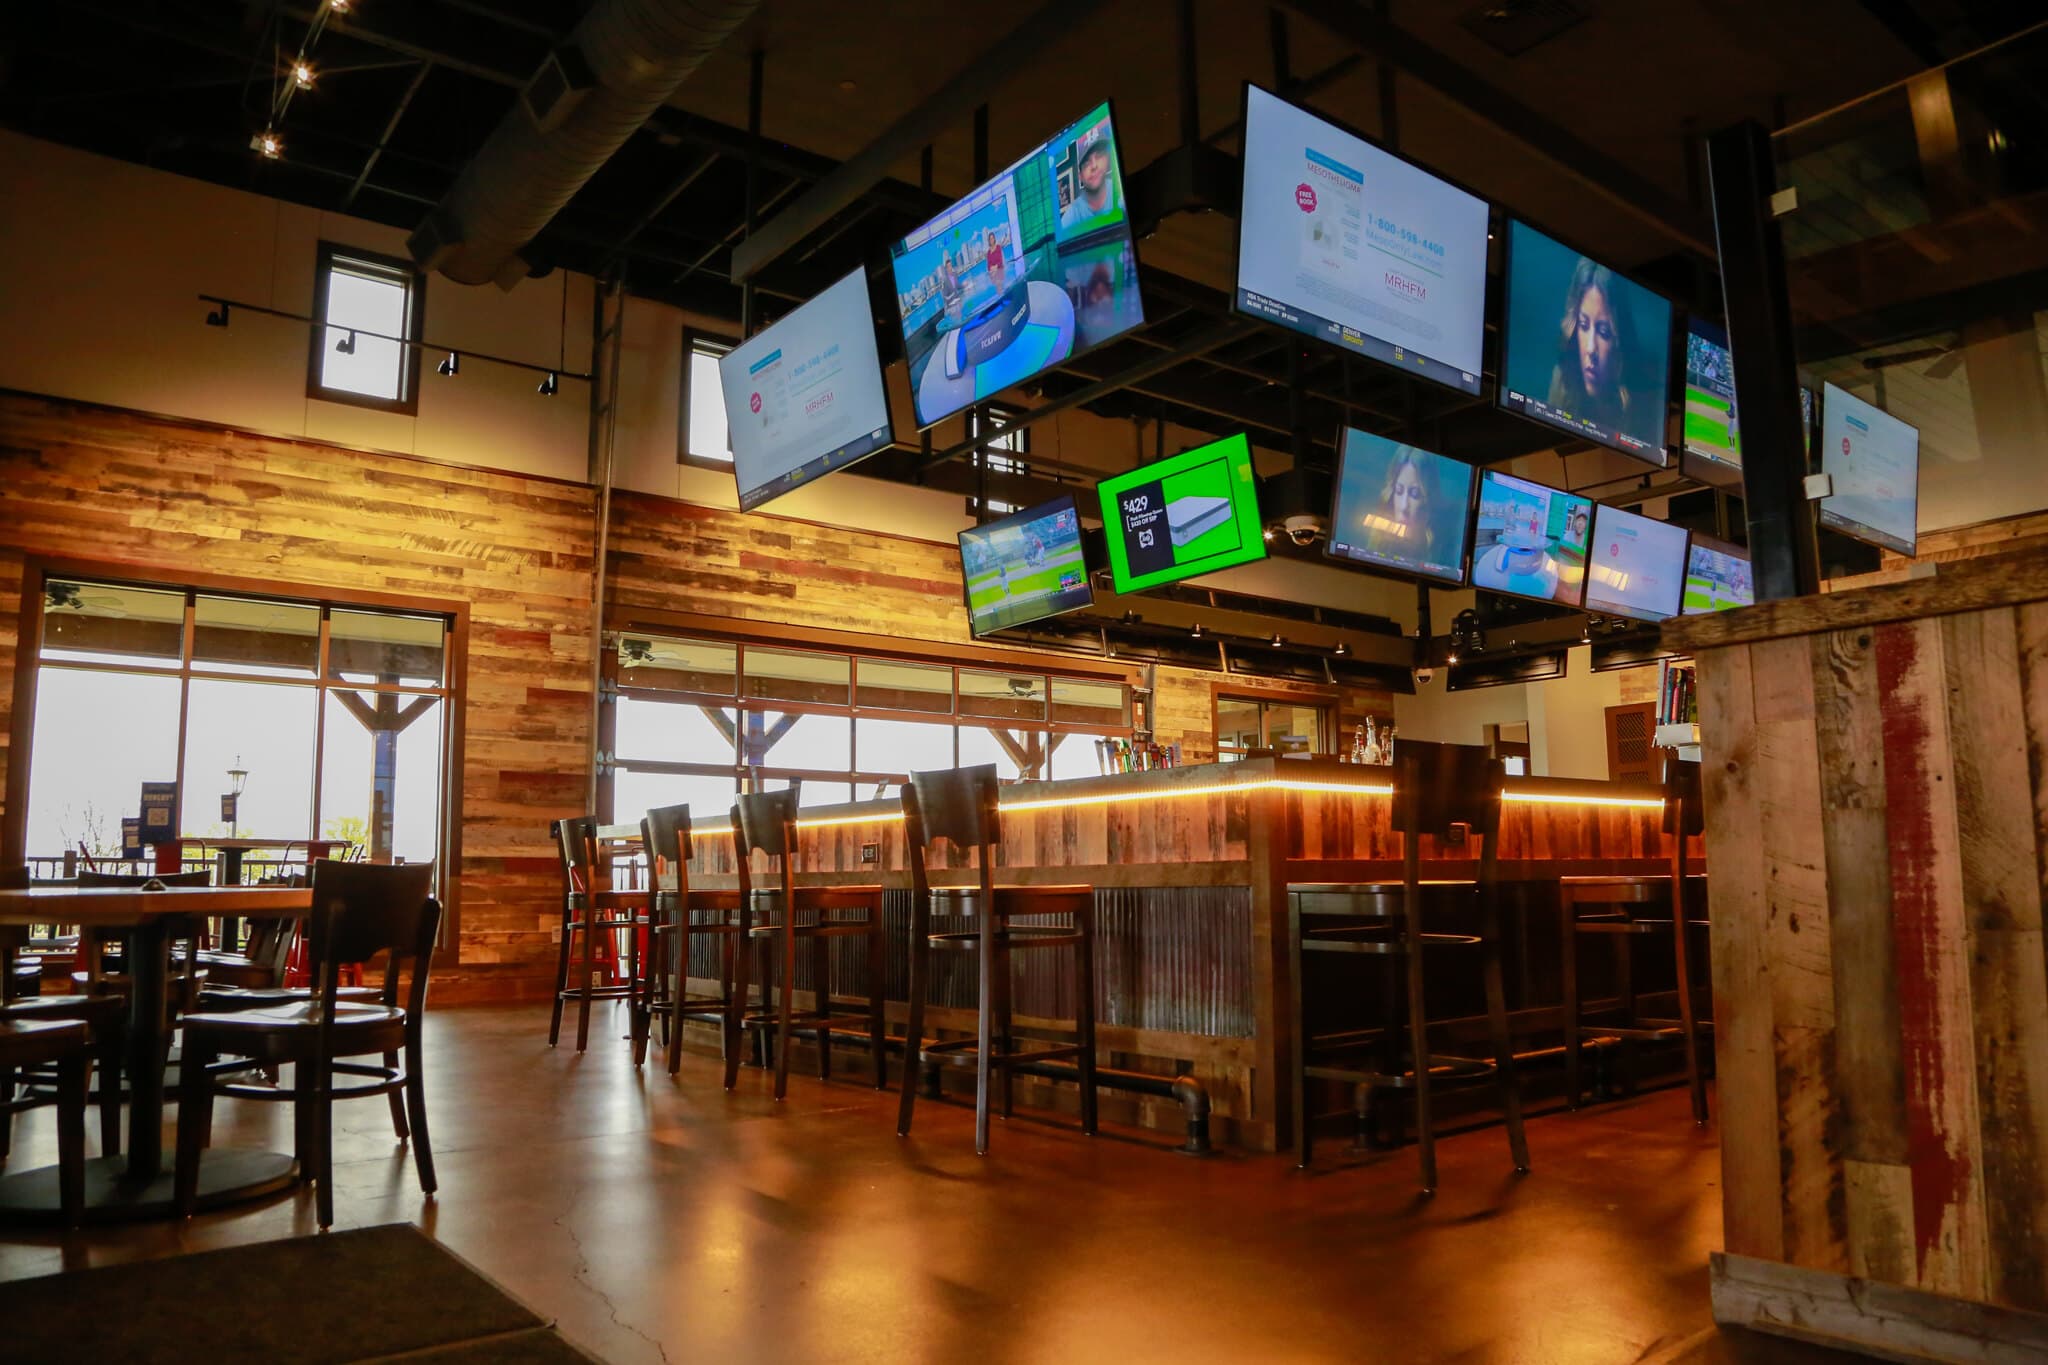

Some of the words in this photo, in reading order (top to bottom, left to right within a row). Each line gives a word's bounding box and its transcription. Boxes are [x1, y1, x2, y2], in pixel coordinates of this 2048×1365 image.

[1307, 161, 1361, 193] MESOTHELIOMA
[1299, 190, 1312, 199] FREE
[1299, 198, 1314, 206] BOOK
[1384, 271, 1426, 301] MRHFM
[1123, 495, 1148, 513] $429
